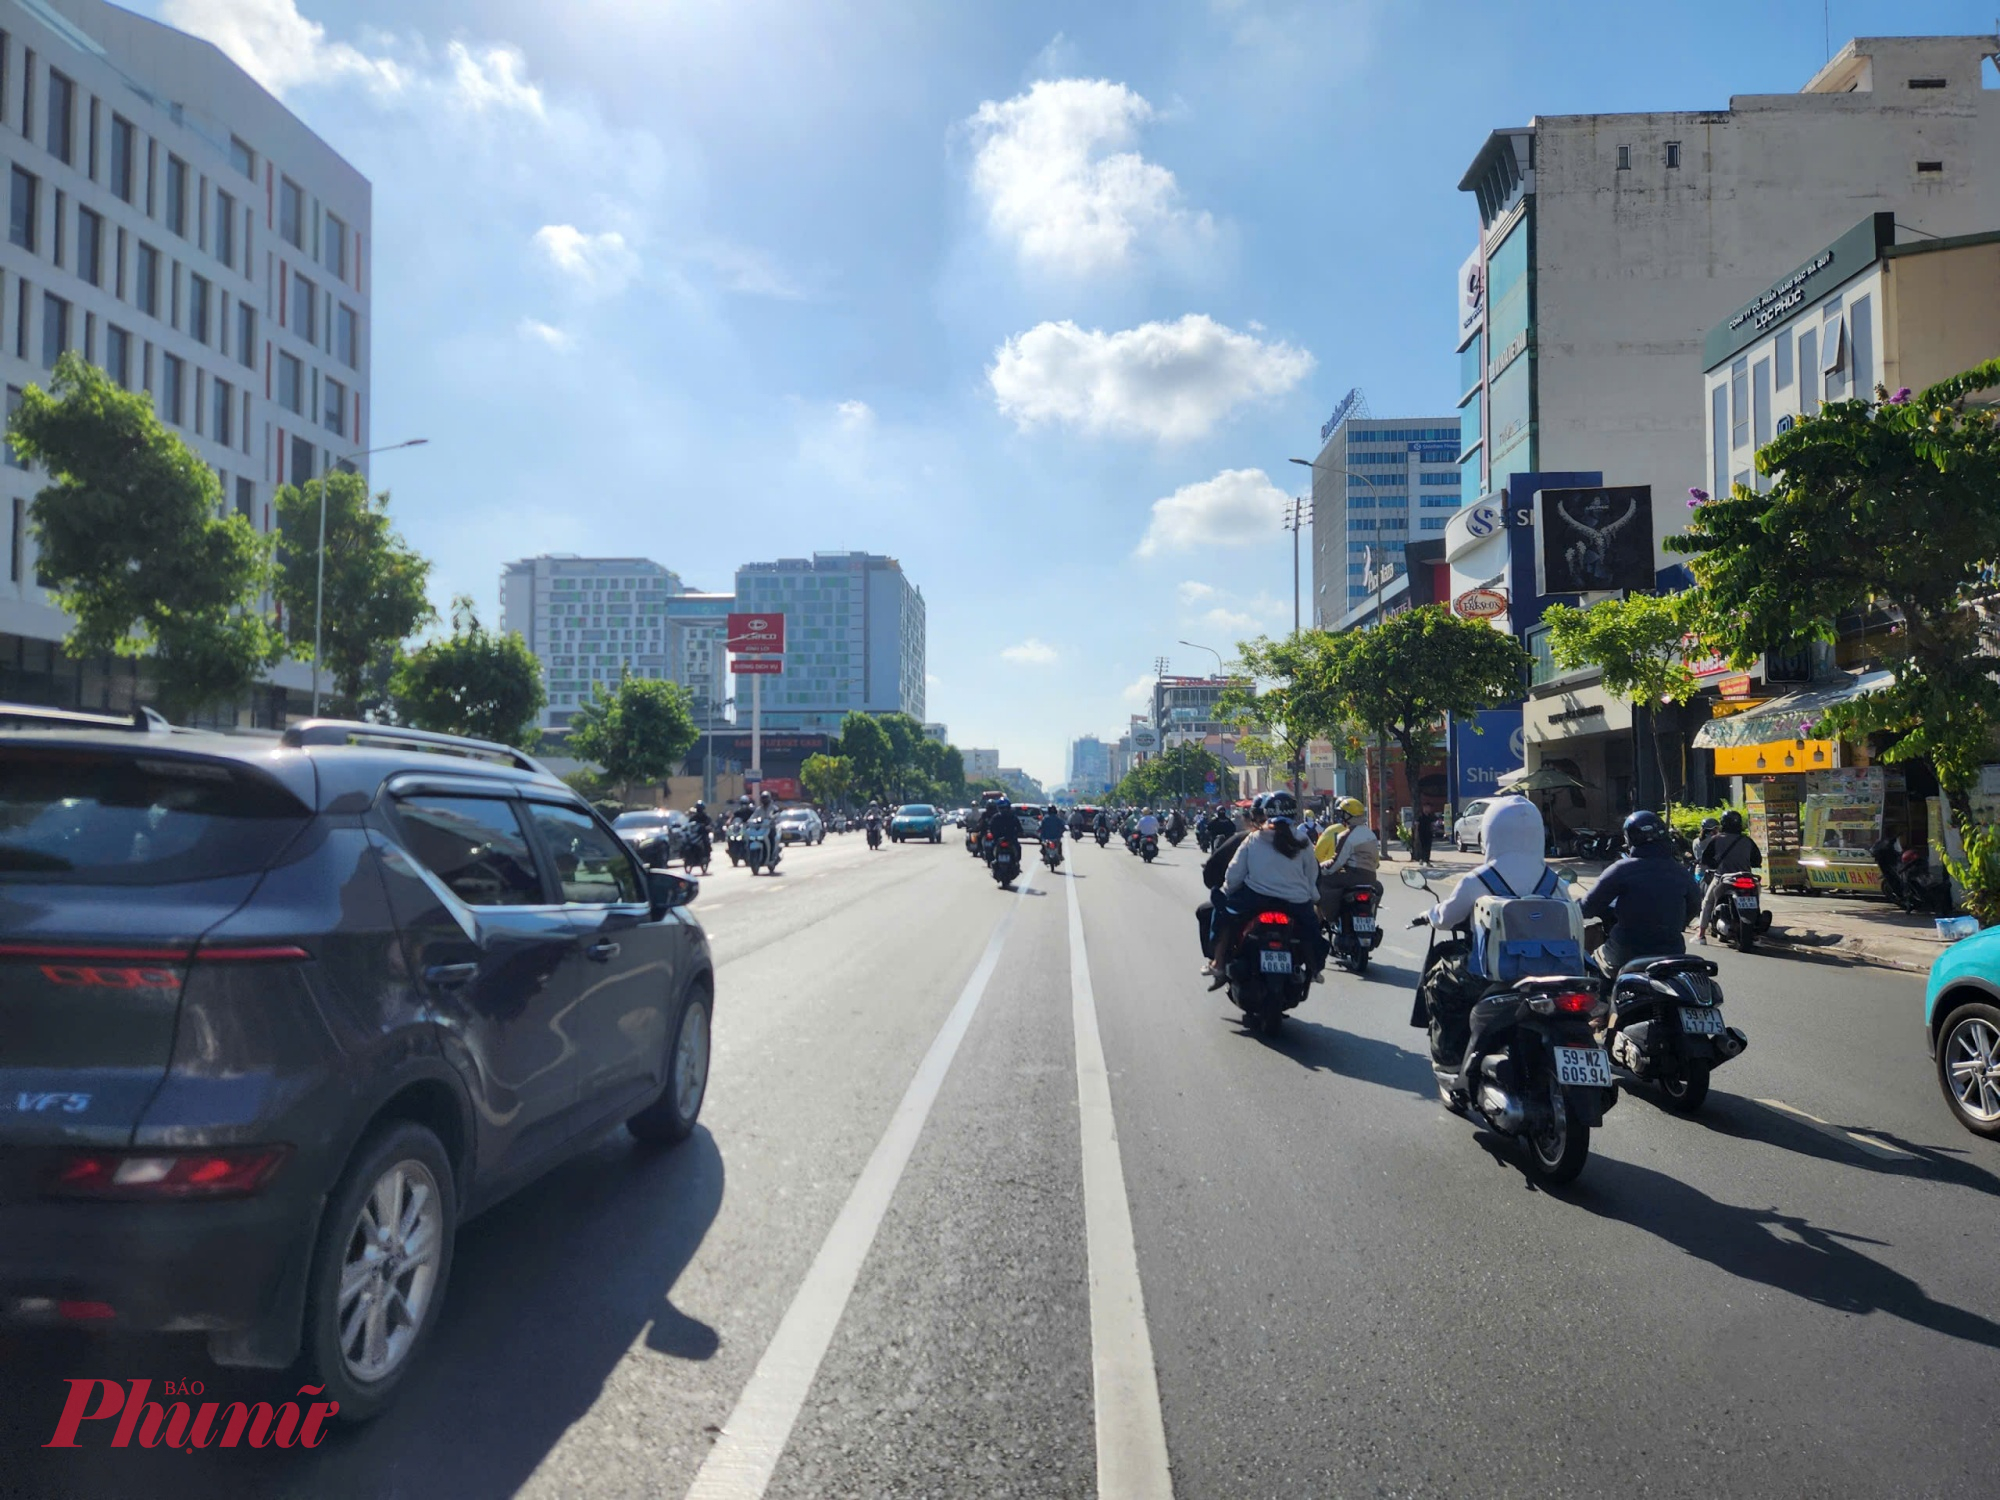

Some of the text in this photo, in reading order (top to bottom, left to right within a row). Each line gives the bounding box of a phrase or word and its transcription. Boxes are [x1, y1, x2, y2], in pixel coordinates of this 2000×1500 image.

[1755, 288, 1801, 329] LỘC PHÚC
[1562, 1066, 1608, 1085] 605.94
